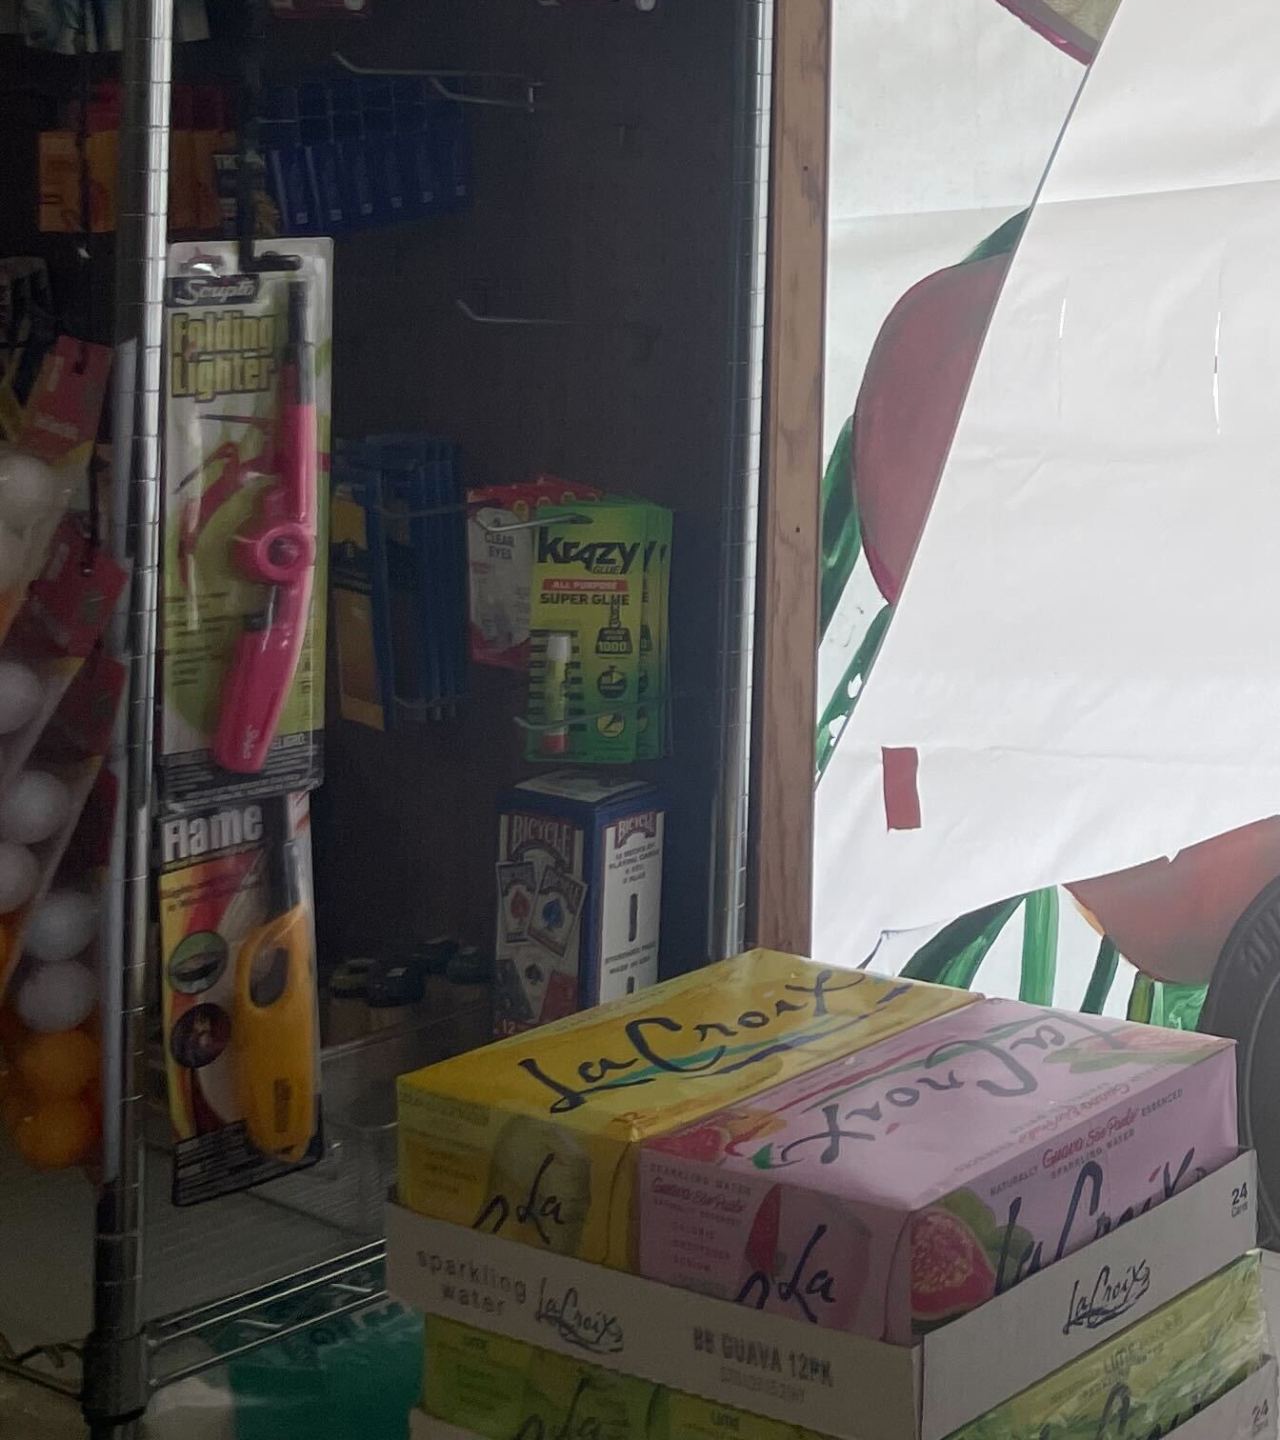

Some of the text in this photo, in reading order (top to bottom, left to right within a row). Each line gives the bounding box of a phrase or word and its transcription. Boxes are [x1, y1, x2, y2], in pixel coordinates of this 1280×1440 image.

[171, 309, 276, 355] Folding
[171, 353, 275, 403] Lighter
[540, 593, 630, 607] SUPER GLUE
[162, 804, 265, 862] Flame
[511, 814, 574, 864] BICYCLE
[1231, 1181, 1249, 1206] 24
[415, 1249, 528, 1304] sparkling
[721, 1331, 782, 1373] GUAVA
[440, 1281, 507, 1317] water
